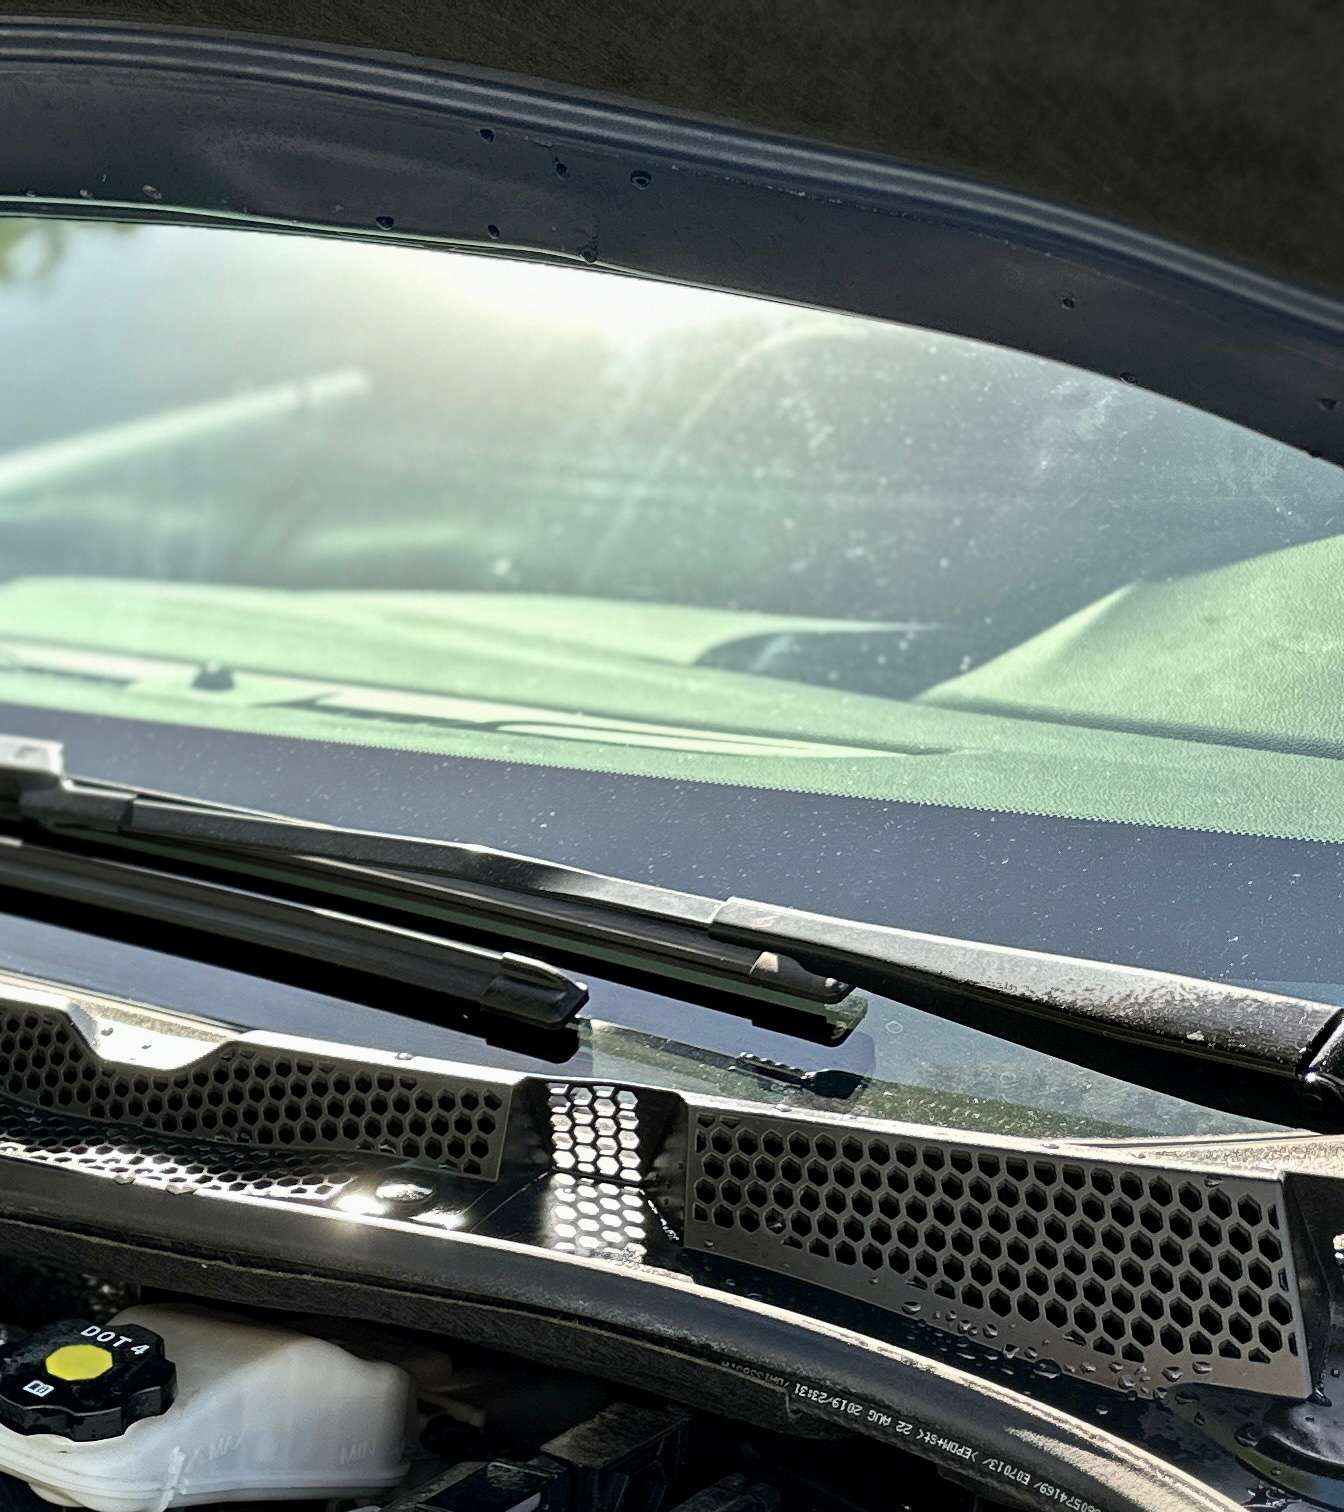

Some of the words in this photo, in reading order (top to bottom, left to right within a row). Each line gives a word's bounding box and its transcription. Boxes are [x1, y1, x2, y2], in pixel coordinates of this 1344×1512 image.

[80, 1325, 132, 1348] DOT
[130, 1344, 150, 1355] 4
[794, 1382, 863, 1416] 2019/23:31
[867, 1409, 892, 1426] AUG
[895, 1420, 913, 1435] 22
